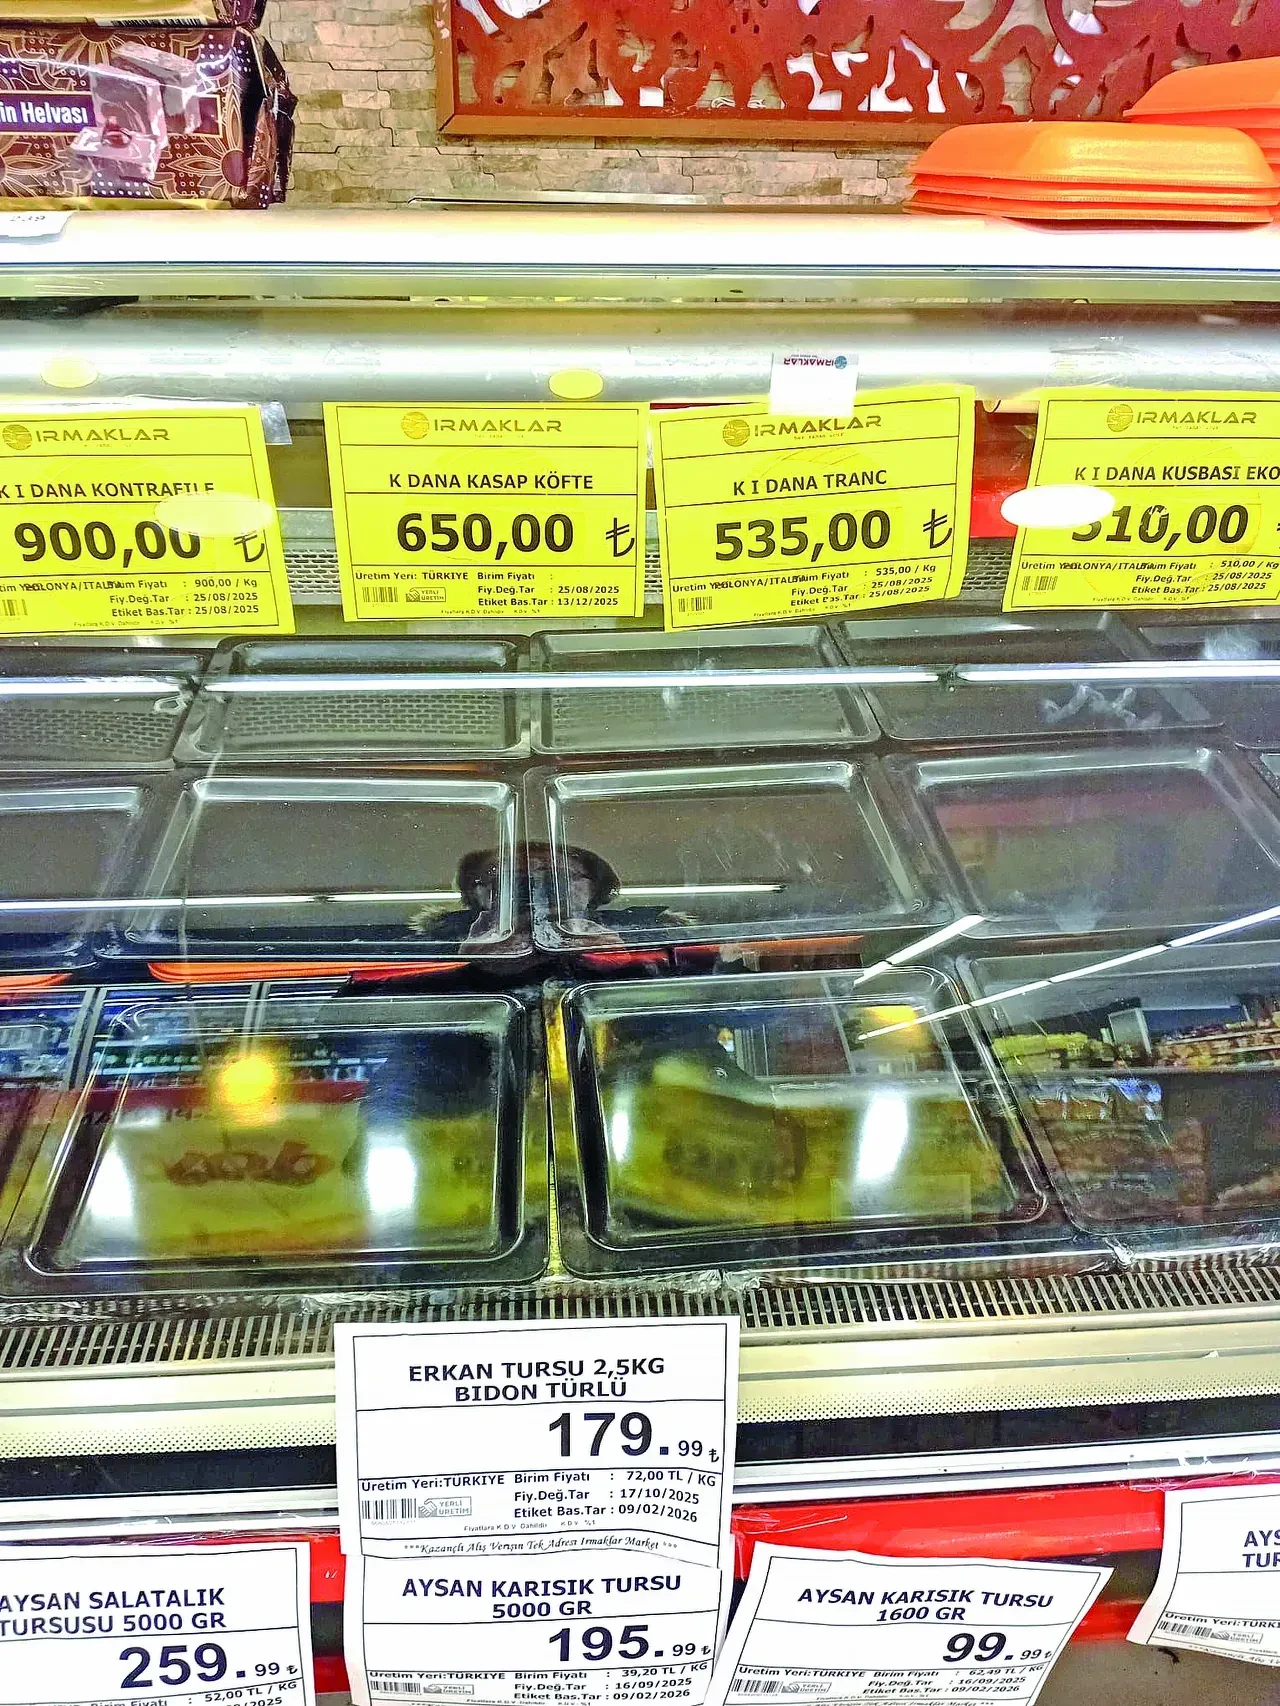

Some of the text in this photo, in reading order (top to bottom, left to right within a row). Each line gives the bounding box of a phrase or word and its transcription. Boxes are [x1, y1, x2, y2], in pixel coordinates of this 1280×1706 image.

[0, 102, 88, 123] in Helvası
[784, 358, 834, 366] IRMAKLAR
[434, 420, 562, 433] IRMAKLAR
[754, 415, 882, 437] IRMAKLAR
[1137, 411, 1257, 425] IRMAKLAR
[36, 429, 170, 442] IRMAKLAR
[389, 470, 593, 489] K DANA KASAP KÖFTE
[1075, 466, 1280, 480] K I DANA KUSBASI EKO
[0, 485, 10, 498] K
[17, 485, 25, 498] I
[31, 483, 87, 498] DANA
[734, 470, 887, 496] K I DANA TRANC
[15, 521, 201, 568] 900,00
[398, 513, 574, 560] 650,00
[715, 510, 890, 562] 535,00
[822, 571, 849, 582] Fiyatı
[876, 566, 911, 576] 535,00
[923, 564, 936, 574] Kg
[1170, 562, 1196, 571] Fiyatı
[1266, 561, 1279, 570] Kg
[139, 579, 168, 589] Fiyatı
[194, 579, 231, 588] 900,00
[243, 579, 257, 588] Kg
[422, 570, 468, 580] TÜRKIYE
[477, 572, 505, 580] Birim
[508, 572, 535, 581] Fiyatı
[871, 577, 933, 589] 25/08/2025
[1213, 572, 1272, 581] 25/08/2025
[478, 586, 620, 595] Fiy.Değ.Tar 25/08/2025
[790, 597, 819, 606] Etiket
[869, 586, 930, 598] 25/08/2025
[1132, 583, 1266, 594] Etiket Bas.Tar 25/08/2025
[194, 593, 258, 602] 25/08/2025
[478, 598, 619, 606] Etiket Bas.Tar 13/12/2025
[112, 605, 259, 617] Etiket Bas.Tar 25/08/2025
[409, 1357, 665, 1382] ERKAN TURSU 2,5KG
[455, 1377, 627, 1401] BIDON TÜRLÜ
[515, 1471, 549, 1484] Birim
[554, 1471, 590, 1485] Fiyatı
[626, 1470, 663, 1483] 72,00
[669, 1470, 684, 1482] TL
[698, 1474, 716, 1487] KG
[515, 1487, 700, 1505] Fiy.Değ.Tar 17/10/2025
[515, 1503, 698, 1522] Etiket Bas.Tar 09/02/2026
[403, 1575, 681, 1598] AYSAN KARISIK TURSU
[0, 1587, 225, 1612] AYSAN SALATALIK
[797, 1588, 1053, 1608] AYSAN KARISIK TURSU
[493, 1601, 592, 1618] 5000 GR
[876, 1607, 966, 1621] 1600 GR
[0, 1612, 227, 1636] TURSUSU 5000 GR
[515, 1672, 548, 1680] Birim
[553, 1671, 587, 1680] Fiyatı
[621, 1668, 658, 1677] 39,20
[662, 1667, 675, 1675] TL
[690, 1662, 708, 1671] KG
[514, 1678, 692, 1692] Fiy.Değ.Tar 16/09/2025
[958, 1676, 1026, 1685] 16/09/2025
[204, 1690, 242, 1702] 52,00
[247, 1688, 262, 1696] TL
[279, 1682, 298, 1691] KG
[613, 1690, 690, 1700] 09/02/2026
